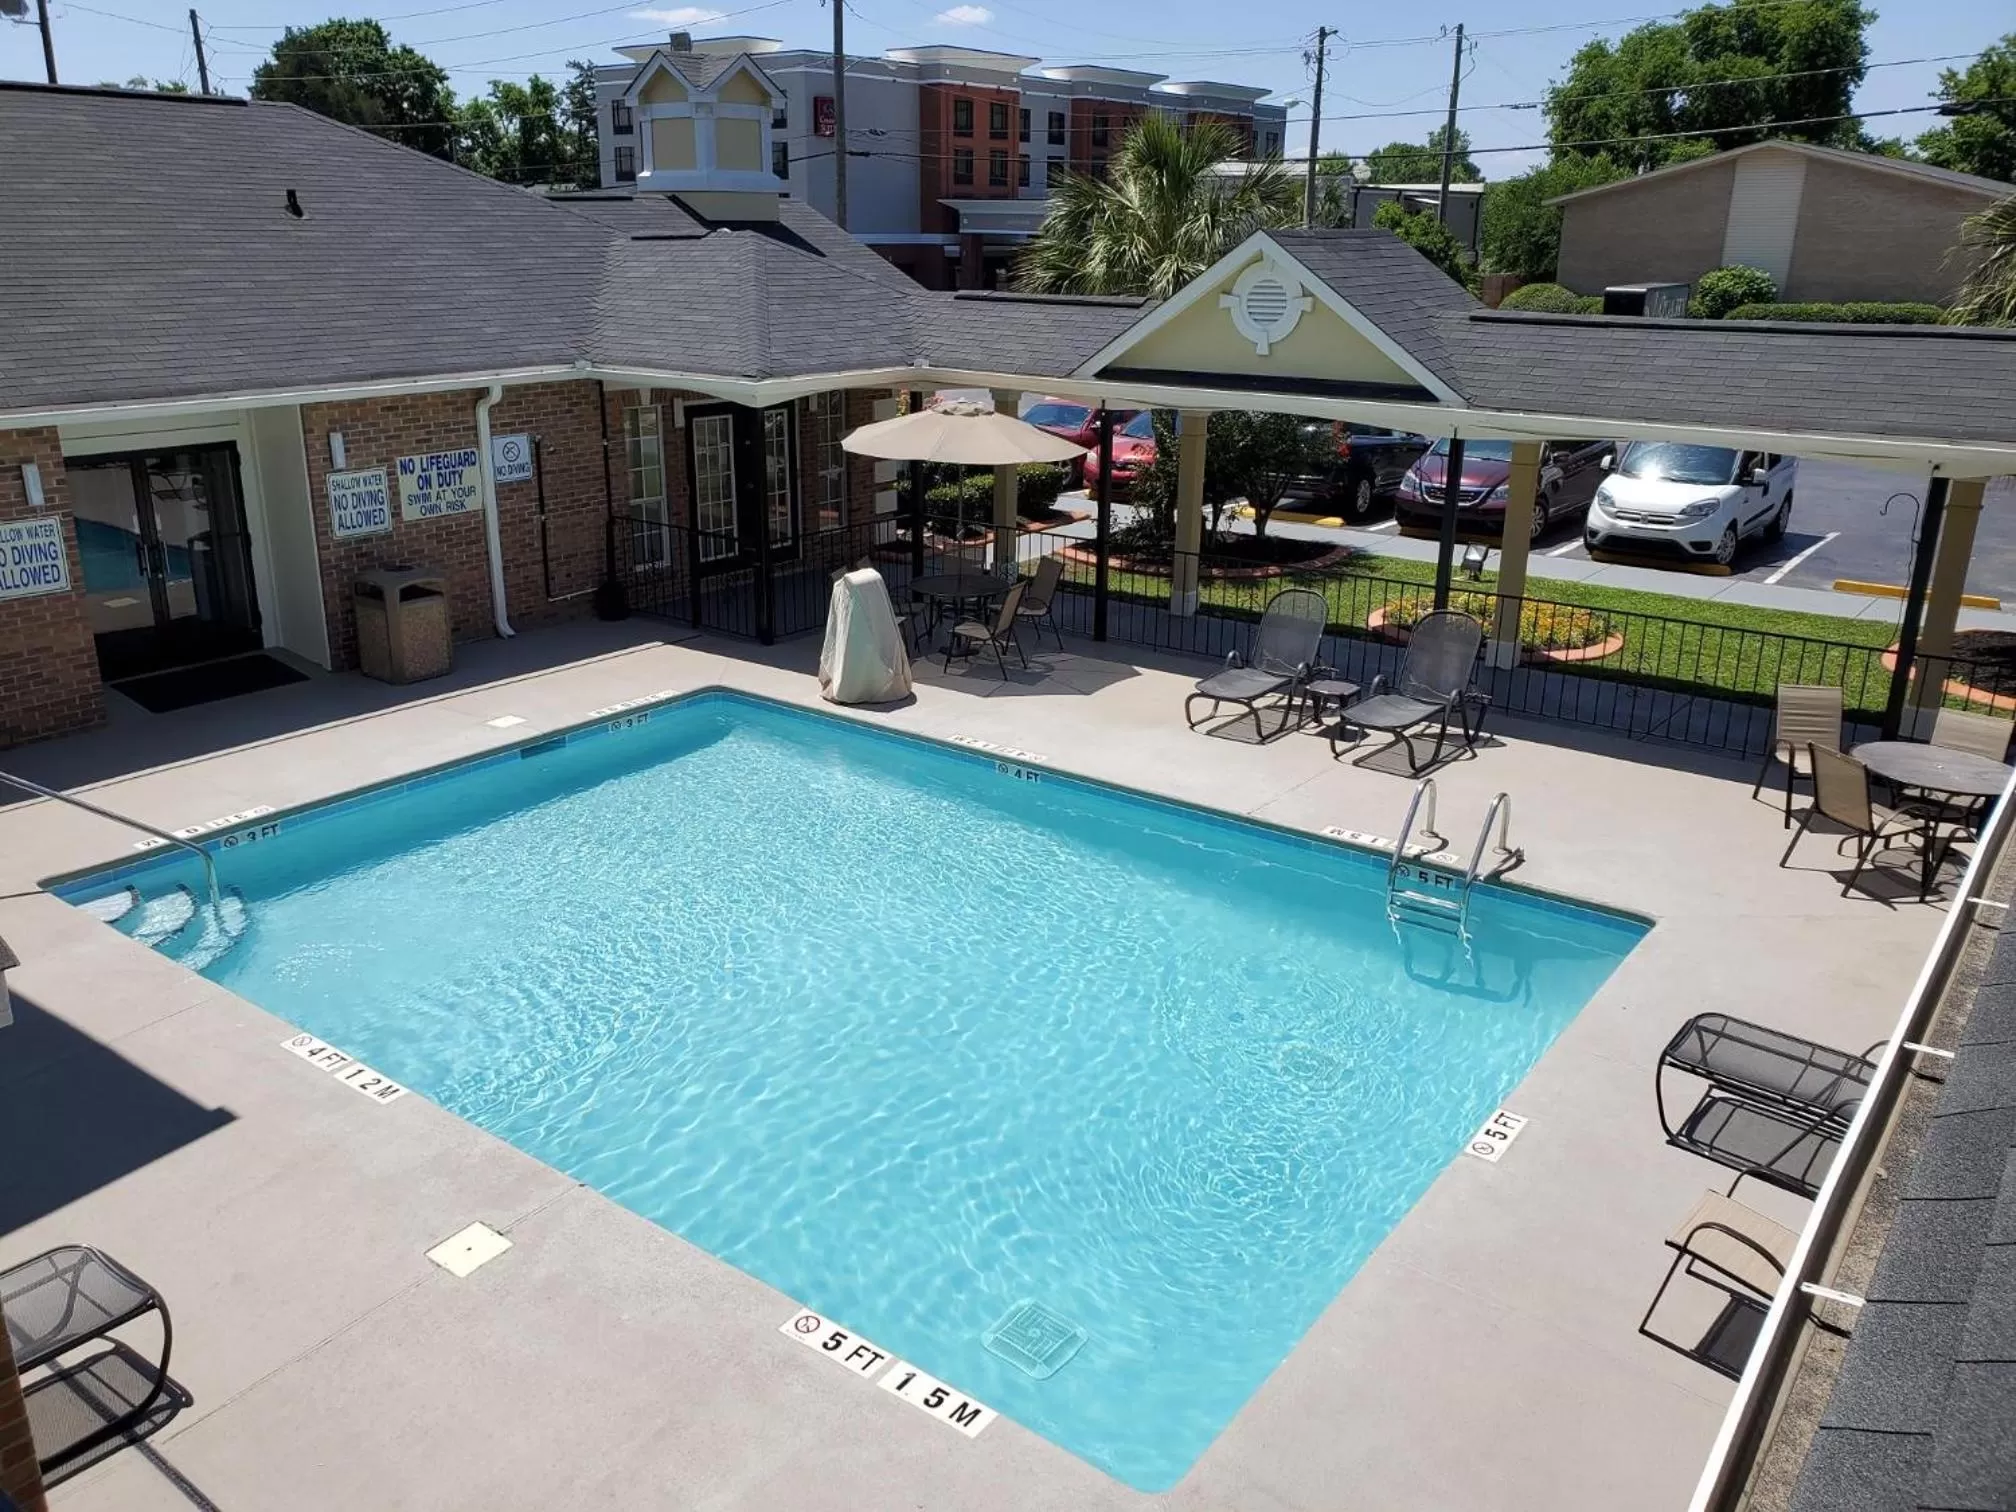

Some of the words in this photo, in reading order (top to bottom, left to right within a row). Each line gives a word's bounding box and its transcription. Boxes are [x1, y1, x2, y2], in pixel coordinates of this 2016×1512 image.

[400, 458, 415, 475] NO
[420, 450, 477, 473] LIFEGUARD
[496, 465, 506, 478] NO
[507, 462, 531, 476] DIVING
[331, 476, 361, 492] SHALLOW
[362, 473, 384, 488] WATER
[417, 474, 432, 490] ON
[437, 469, 464, 488] DUTY
[334, 493, 349, 512] NO
[351, 488, 385, 510] DIVING
[407, 491, 432, 506] SWIM
[436, 488, 447, 501] AT
[451, 485, 477, 500] YOUR
[420, 504, 442, 516] OWN
[446, 499, 467, 513] RISK
[337, 507, 386, 531] ALLOWED
[0, 526, 23, 543] LLOW
[25, 523, 56, 540] WATER
[0, 547, 7, 567] O
[11, 541, 59, 566] DIVING
[1026, 771, 1040, 783] FT
[247, 831, 257, 842] 3
[261, 822, 279, 838] FT
[1418, 870, 1429, 883] 5
[1434, 875, 1454, 890] FT
[307, 1047, 328, 1058] 4
[317, 1052, 348, 1068] FT
[1493, 1112, 1521, 1130] FT
[1484, 1128, 1508, 1141] 5
[822, 1331, 848, 1351] 5
[844, 1344, 884, 1371] FT
